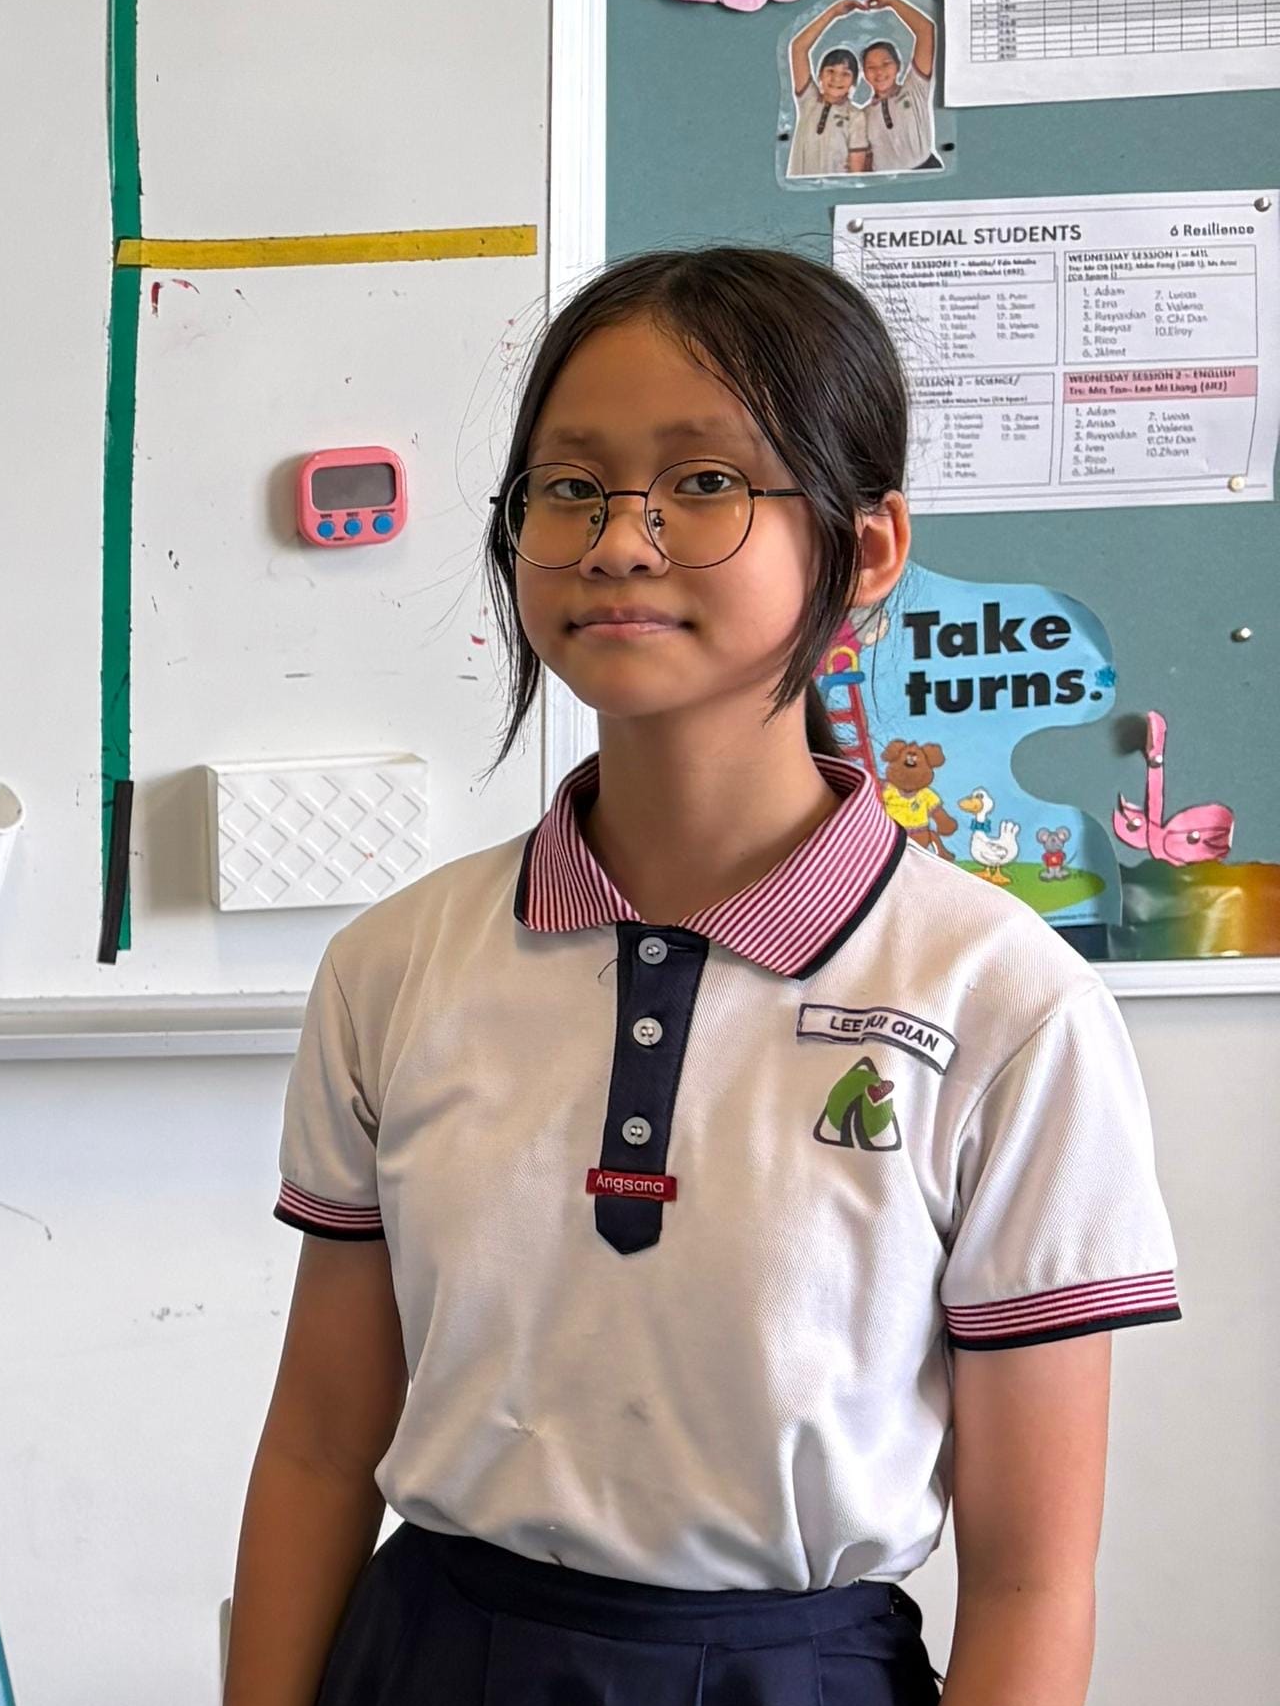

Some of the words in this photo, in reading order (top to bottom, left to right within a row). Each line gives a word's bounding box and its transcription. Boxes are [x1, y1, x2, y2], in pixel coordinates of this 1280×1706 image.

[863, 228, 967, 249] REMEDIAL
[974, 224, 1081, 244] STUDENTS
[1184, 222, 1254, 236] Resilience
[903, 602, 1071, 660] Take
[905, 667, 1103, 716] turns.
[830, 1015, 863, 1032] LEE
[892, 1021, 939, 1052] QIAN
[595, 1173, 664, 1194] Angsana
